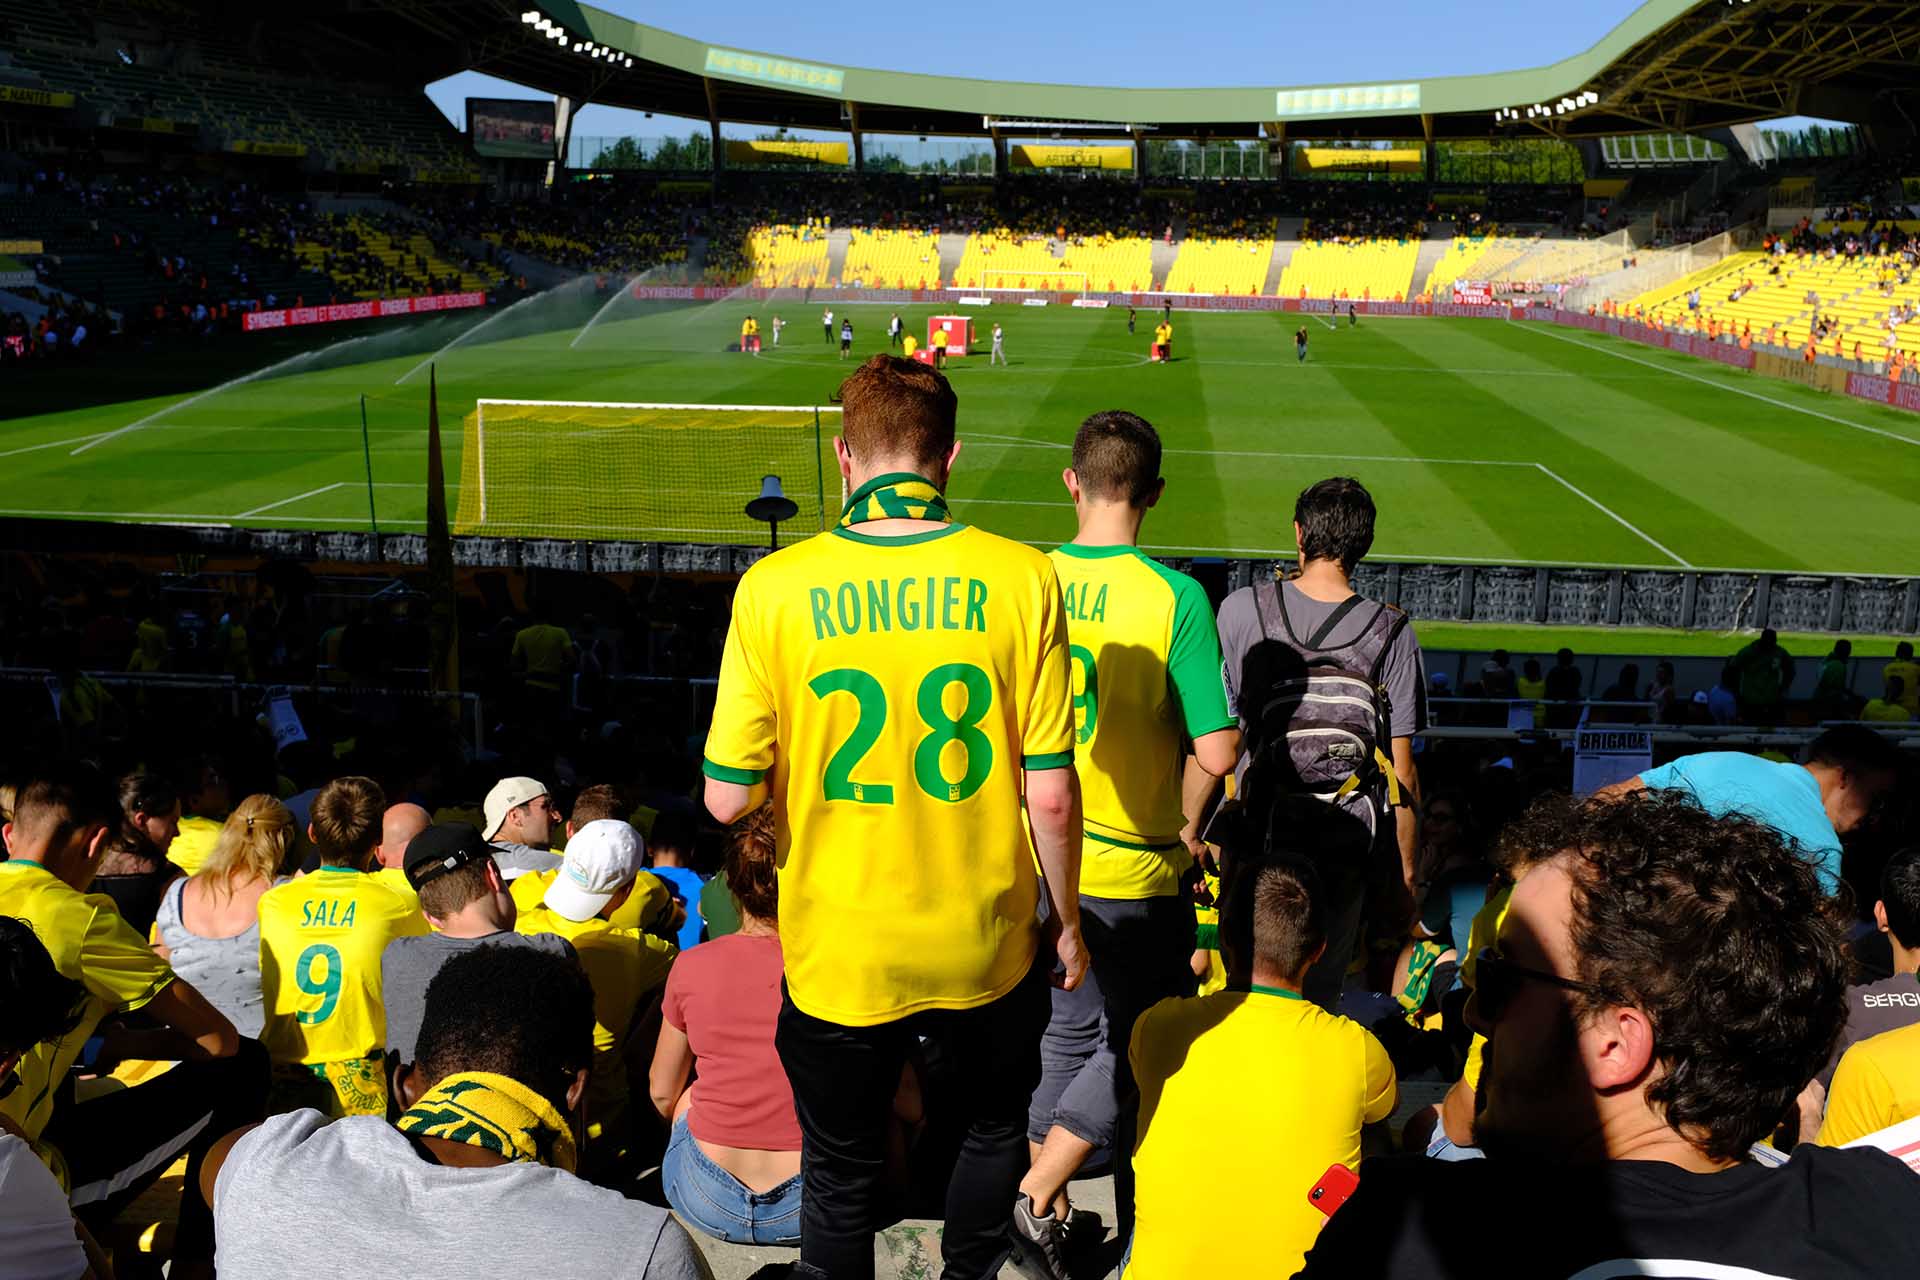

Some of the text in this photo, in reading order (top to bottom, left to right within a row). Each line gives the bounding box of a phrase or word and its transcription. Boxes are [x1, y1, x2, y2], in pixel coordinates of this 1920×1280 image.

[248, 309, 286, 330] SYNERGIE
[380, 299, 411, 316] SYNERGIE
[640, 288, 694, 299] SYNERGIE
[1207, 297, 1283, 311] RECRUTEMENT
[1369, 301, 1411, 315] INTERIM
[1850, 374, 1890, 403] SYNERGIE
[810, 577, 988, 640] RONGIER
[1064, 582, 1108, 623] ALA
[808, 663, 993, 804] 28
[301, 900, 356, 927] SALA
[296, 944, 342, 1024] 9
